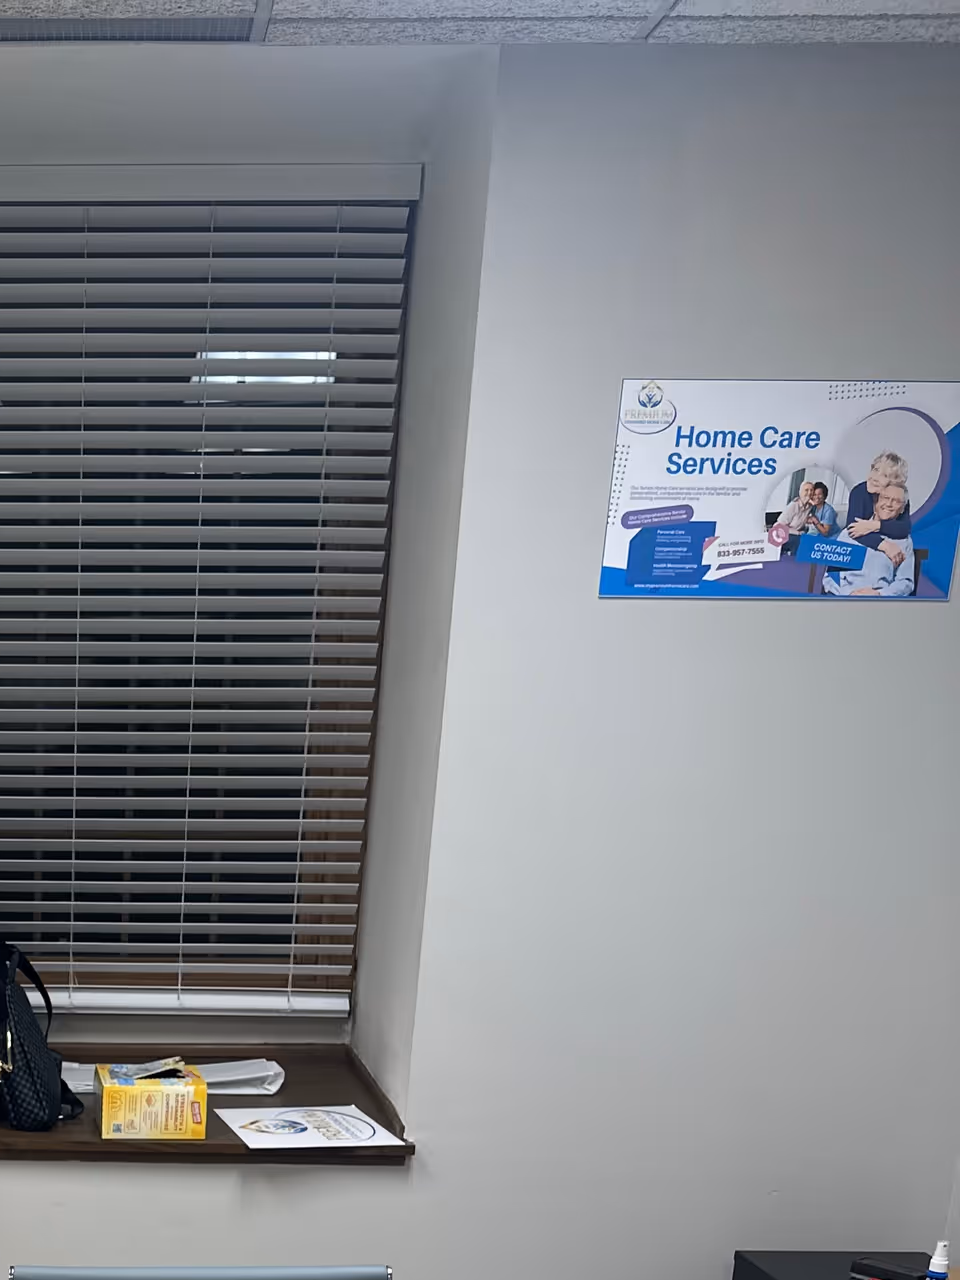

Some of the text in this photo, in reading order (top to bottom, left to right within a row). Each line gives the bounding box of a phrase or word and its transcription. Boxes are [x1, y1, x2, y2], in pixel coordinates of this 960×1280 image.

[675, 426, 821, 449] Home Care
[666, 453, 777, 475] Services
[717, 548, 764, 557] 833-957-7555
[814, 543, 851, 554] CONTACT
[823, 553, 851, 562] TODAY!
